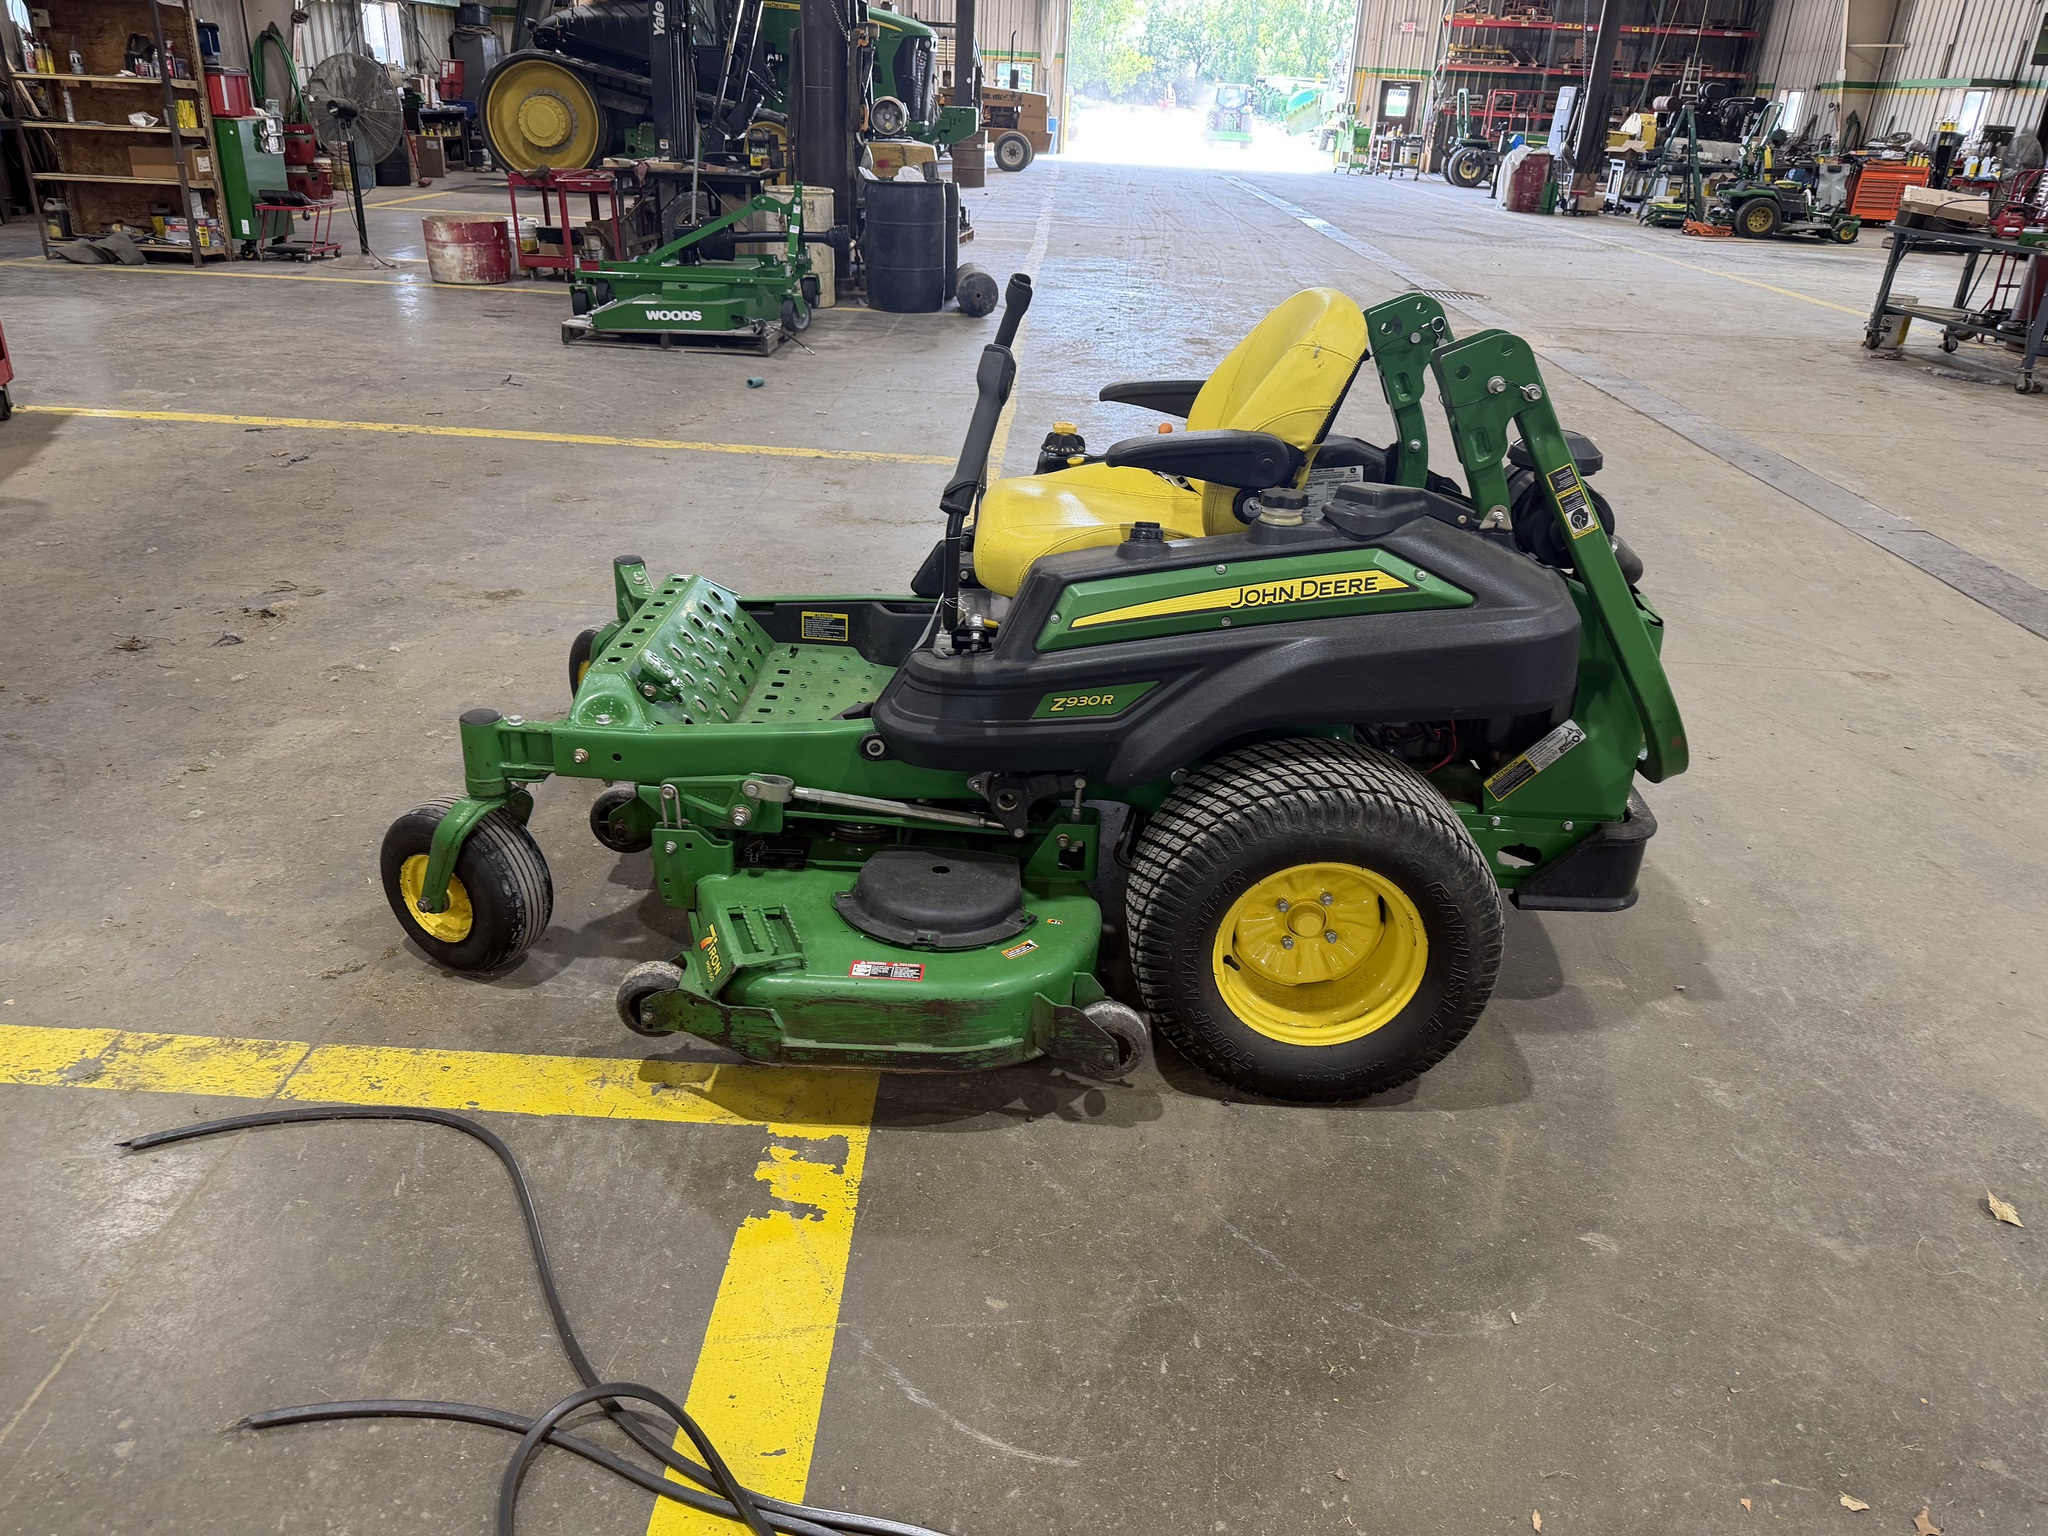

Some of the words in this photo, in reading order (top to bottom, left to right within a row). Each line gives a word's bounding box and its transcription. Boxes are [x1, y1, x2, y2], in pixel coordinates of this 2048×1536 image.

[653, 1, 666, 36] Yale
[645, 309, 703, 322] WOODS
[1230, 584, 1295, 608] JOHN
[1300, 576, 1379, 599] DEERE
[1050, 694, 1115, 712] Z930R
[1187, 1008, 1256, 1072] TURF
